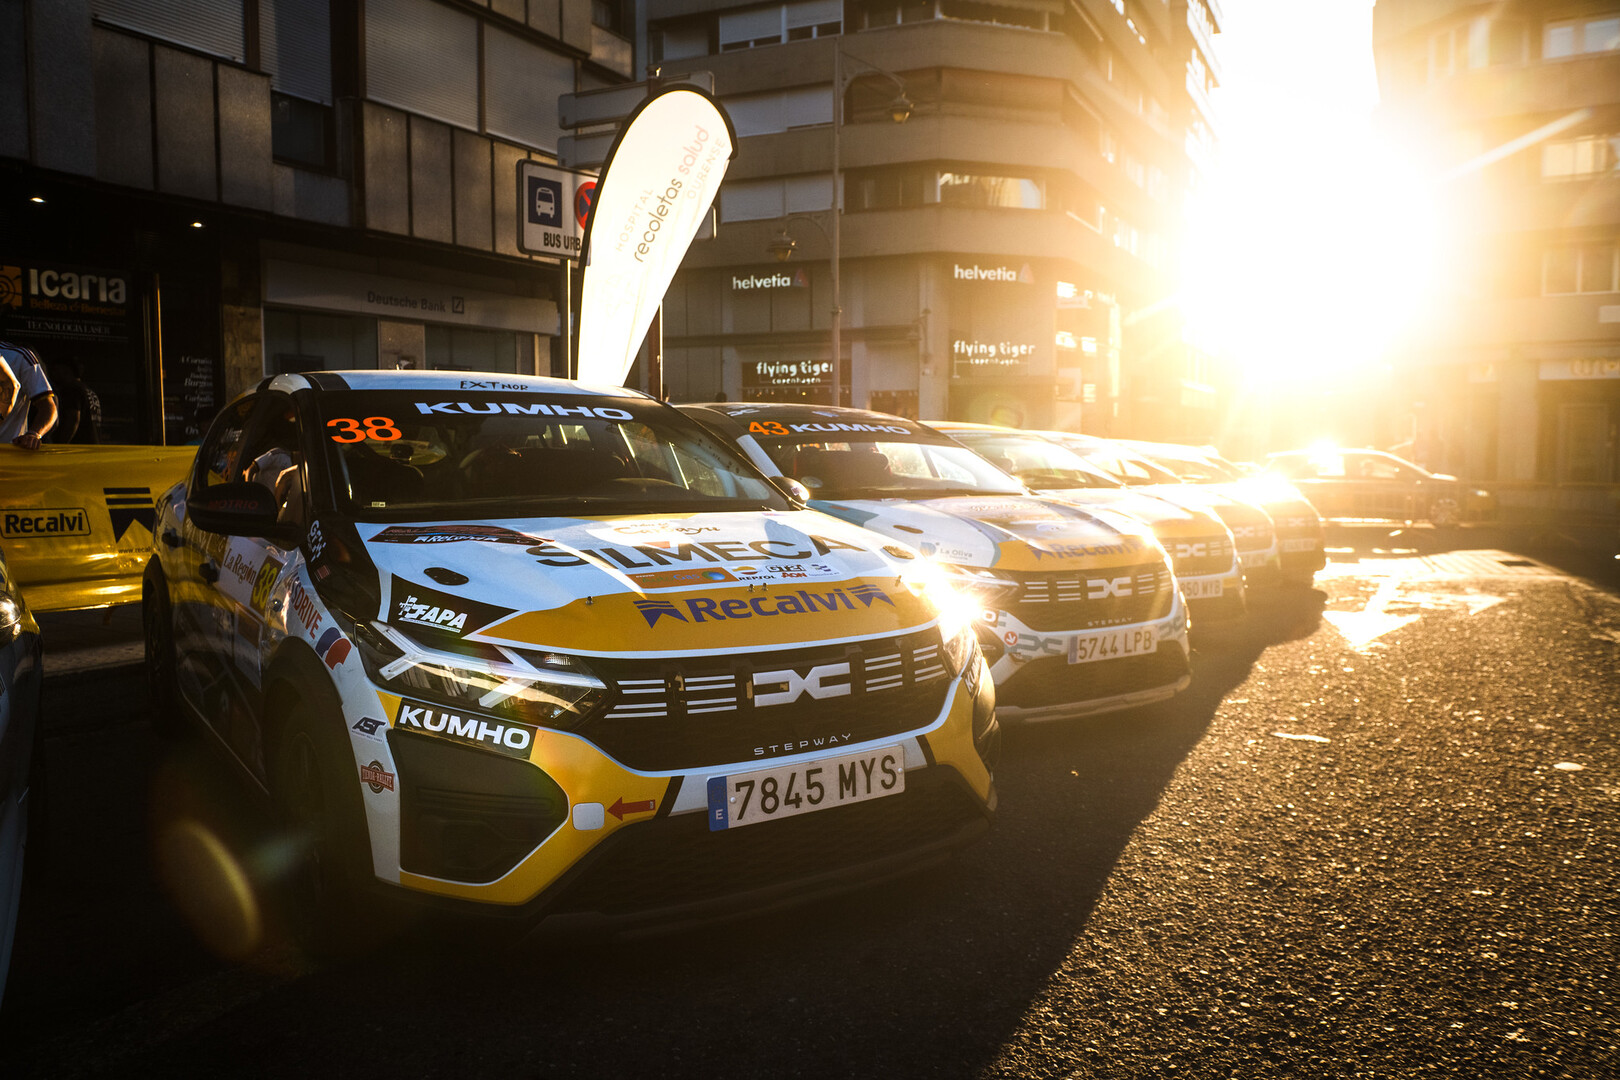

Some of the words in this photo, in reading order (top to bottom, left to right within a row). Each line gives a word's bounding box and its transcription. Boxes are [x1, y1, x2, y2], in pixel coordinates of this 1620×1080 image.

[634, 178, 682, 263] recoletas
[678, 125, 709, 175] salud
[616, 188, 653, 253] HOSPITAL
[543, 232, 561, 248] BUS
[732, 273, 791, 290] helvetia
[954, 264, 1016, 282] helvetia
[367, 290, 417, 309] Deutsche
[421, 299, 446, 313] Bank
[953, 340, 996, 358] flying
[999, 340, 1036, 356] tiger
[756, 361, 797, 377] flying
[970, 356, 1019, 367] copenhagen
[414, 402, 634, 420] KUMHO
[327, 416, 402, 443] 38
[748, 421, 790, 435] 43
[790, 423, 911, 435] KUMHO
[5, 512, 83, 534] Recalvi
[526, 534, 868, 569] SILMECA
[952, 549, 973, 558] Oliva
[253, 562, 277, 609] 38
[404, 604, 468, 629] FAPA
[683, 588, 858, 623] Recalvi
[1088, 617, 1132, 626] STEPWAY
[1078, 634, 1118, 660] 5744
[1124, 630, 1152, 653] LPB
[399, 704, 531, 750] KUMHO
[753, 732, 852, 756] STEPWAY
[735, 767, 825, 821] 7845
[838, 754, 897, 799] MYS
[715, 808, 723, 820] E
